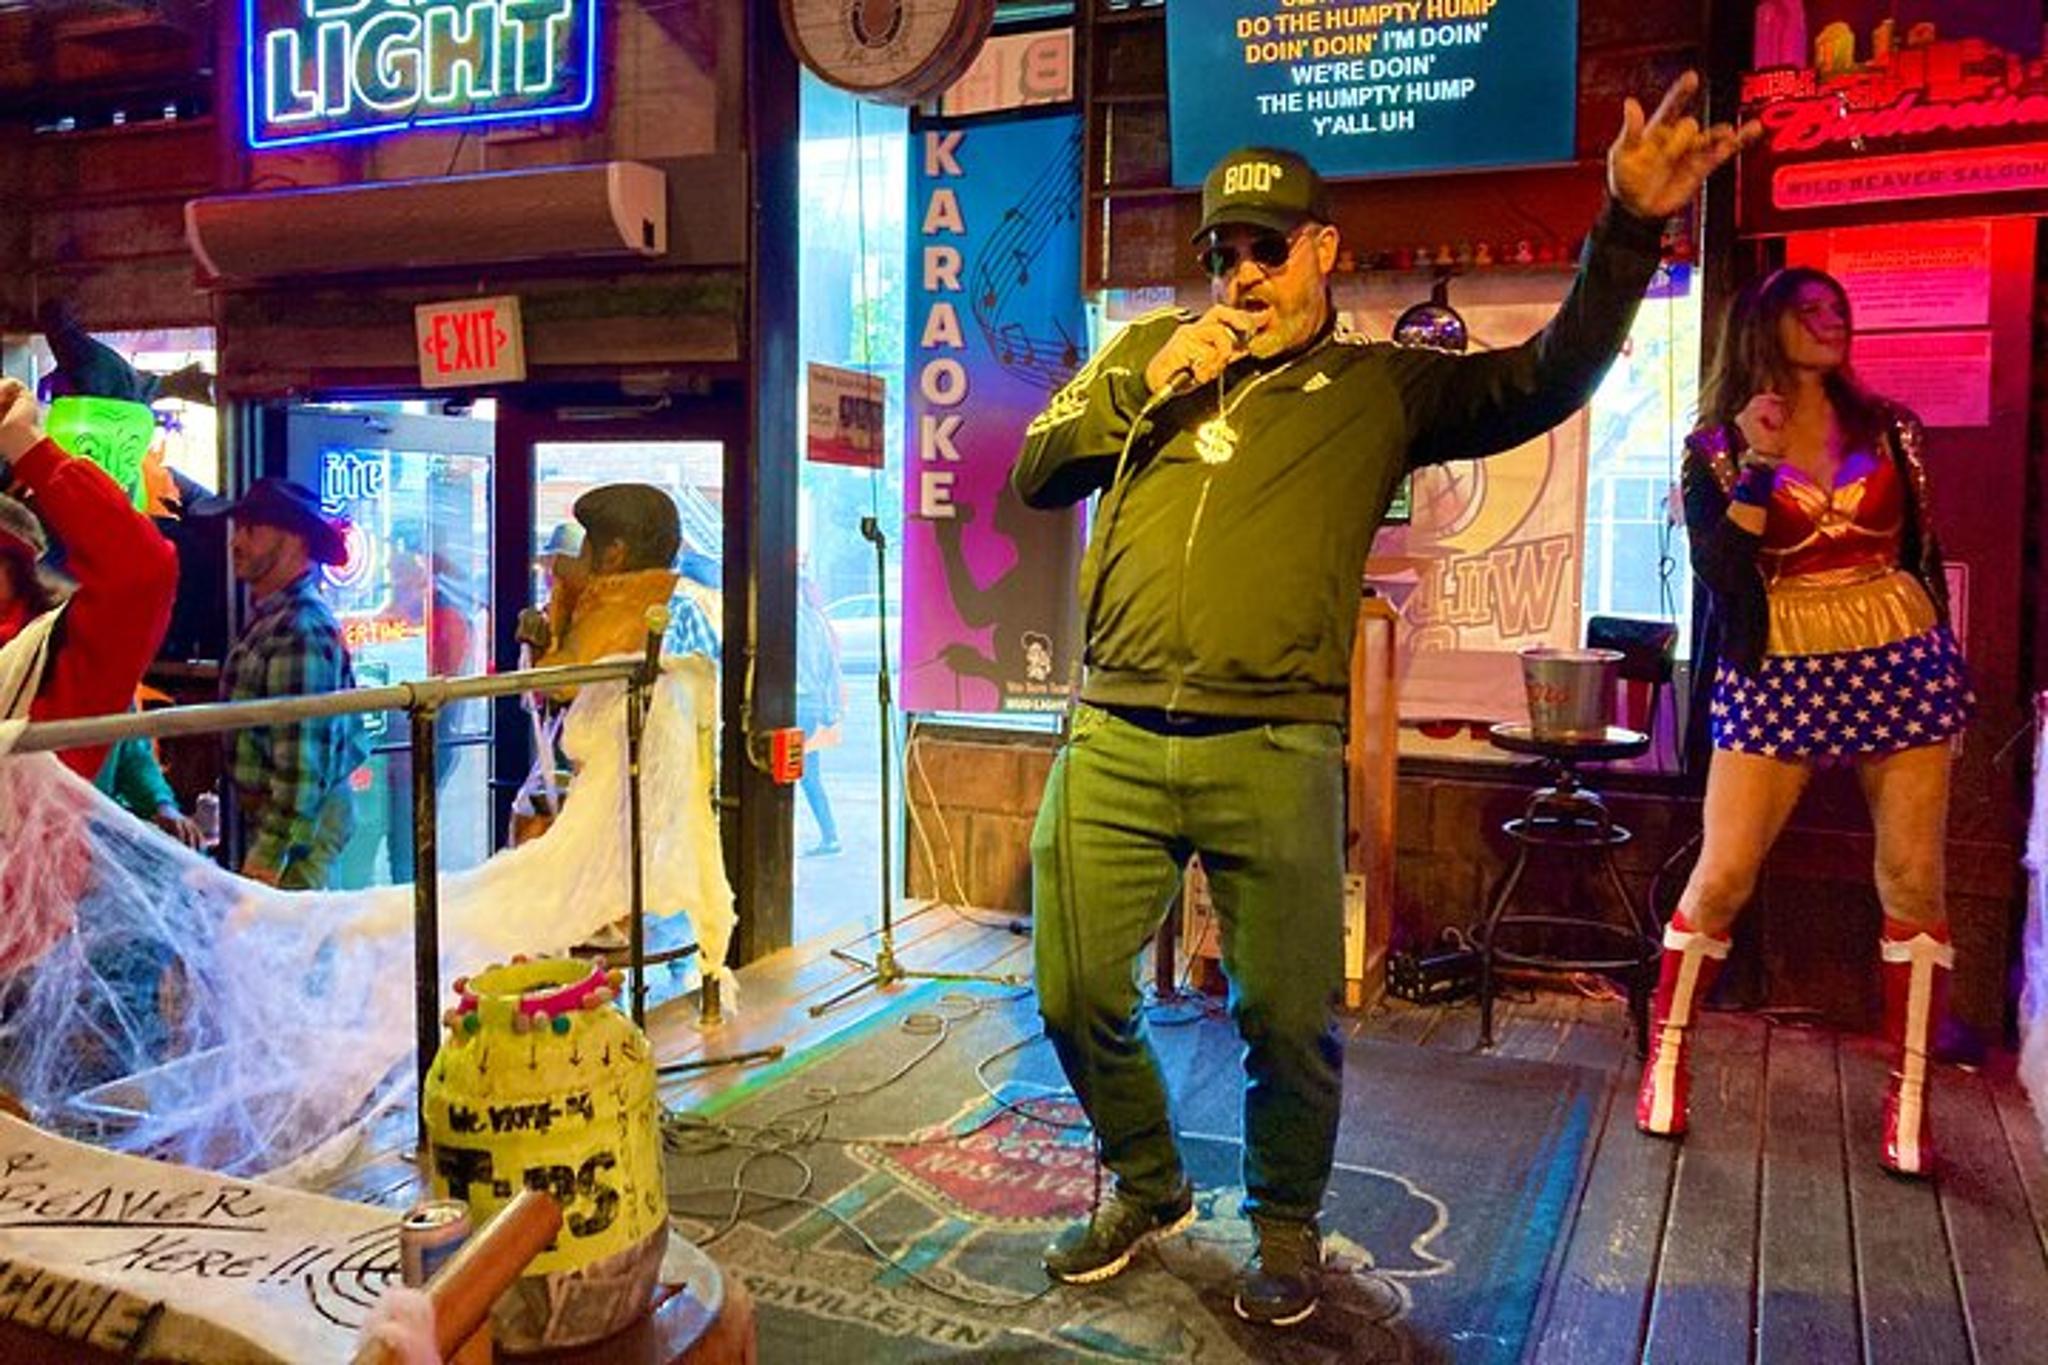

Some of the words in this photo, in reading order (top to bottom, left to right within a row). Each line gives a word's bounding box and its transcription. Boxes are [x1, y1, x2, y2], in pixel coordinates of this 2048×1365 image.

[1237, 18, 1271, 38] DO
[1274, 10, 1321, 34] THE
[1325, 3, 1420, 29] HUMPTY
[1427, 0, 1497, 20] HUMP
[265, 0, 572, 122] LIGHT
[1246, 39, 1309, 63] DOIN'
[1313, 34, 1379, 56] DOIN'
[1384, 29, 1415, 51] I'M
[1420, 22, 1489, 48] DOIN'
[1291, 60, 1364, 85] WE'RE
[1370, 54, 1437, 79] DOIN'
[1257, 93, 1304, 115] THE
[1308, 85, 1401, 111] HUMPTY
[1406, 78, 1477, 102] HUMP
[1312, 113, 1377, 136] Y'ALL
[1381, 110, 1415, 131] UH
[1852, 171, 1944, 192] BEAVER
[1952, 161, 2048, 184] SALOON
[433, 308, 496, 374] EXIT
[921, 131, 970, 519] KARAOKE
[0, 1183, 266, 1219] BEAVER
